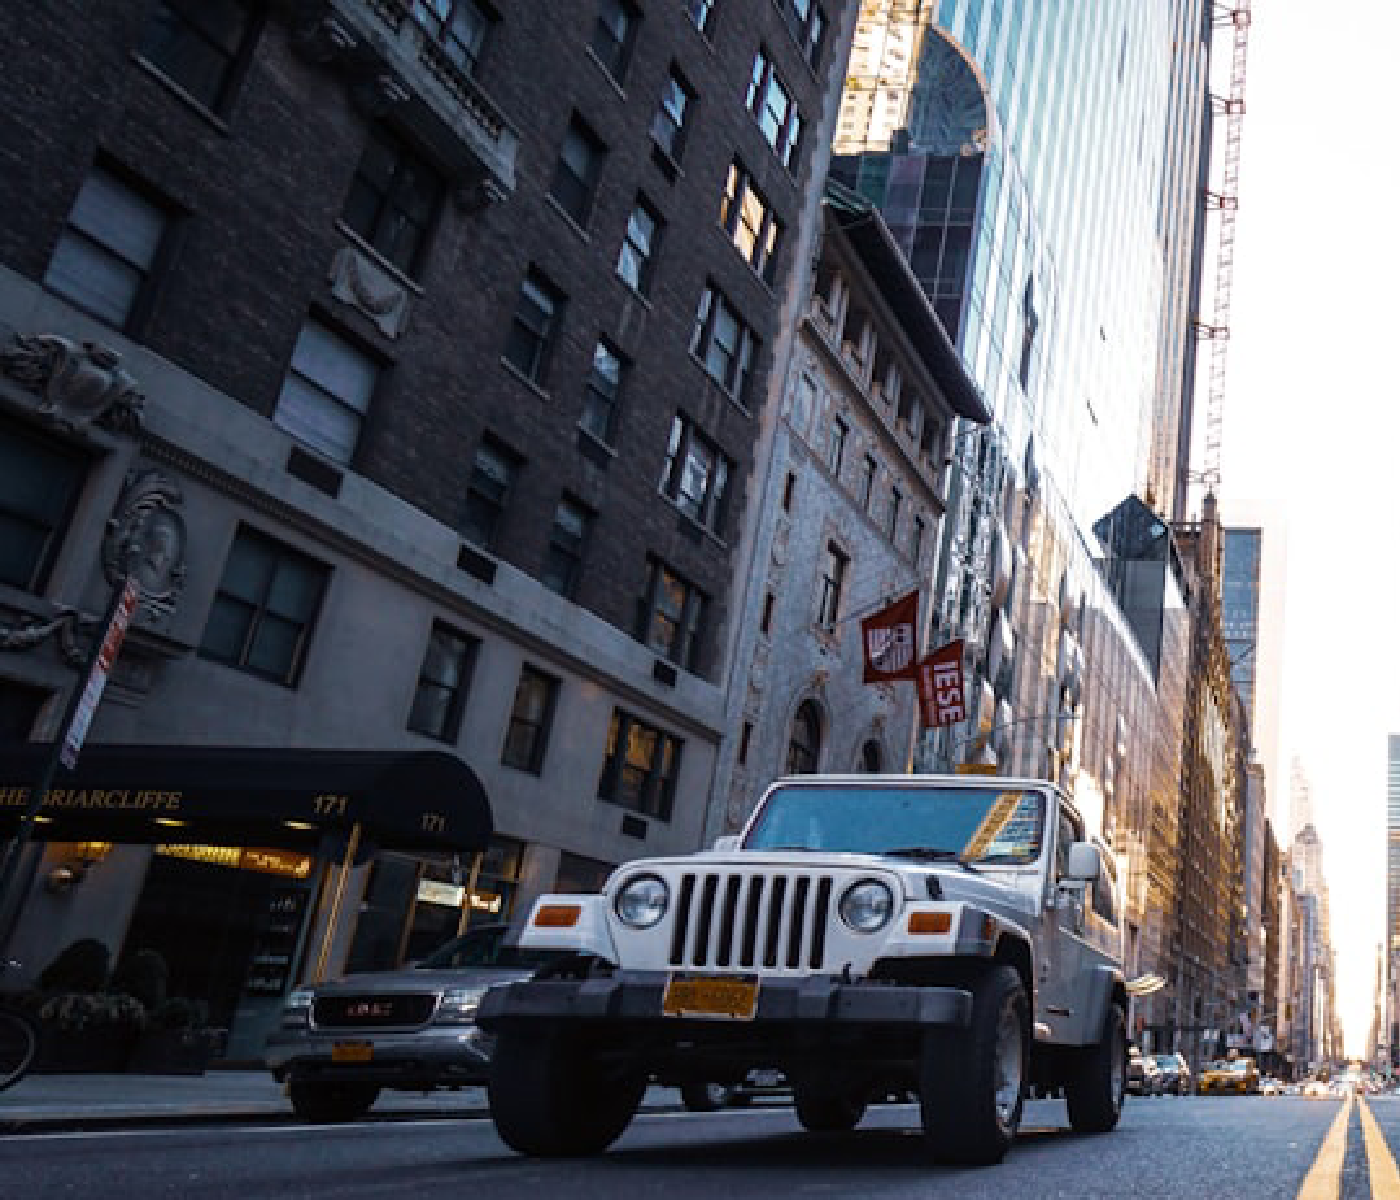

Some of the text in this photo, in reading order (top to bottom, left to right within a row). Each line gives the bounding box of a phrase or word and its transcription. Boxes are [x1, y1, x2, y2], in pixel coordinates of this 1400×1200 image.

[933, 661, 964, 723] IESE
[313, 795, 349, 814] 171
[422, 814, 446, 832] 171
